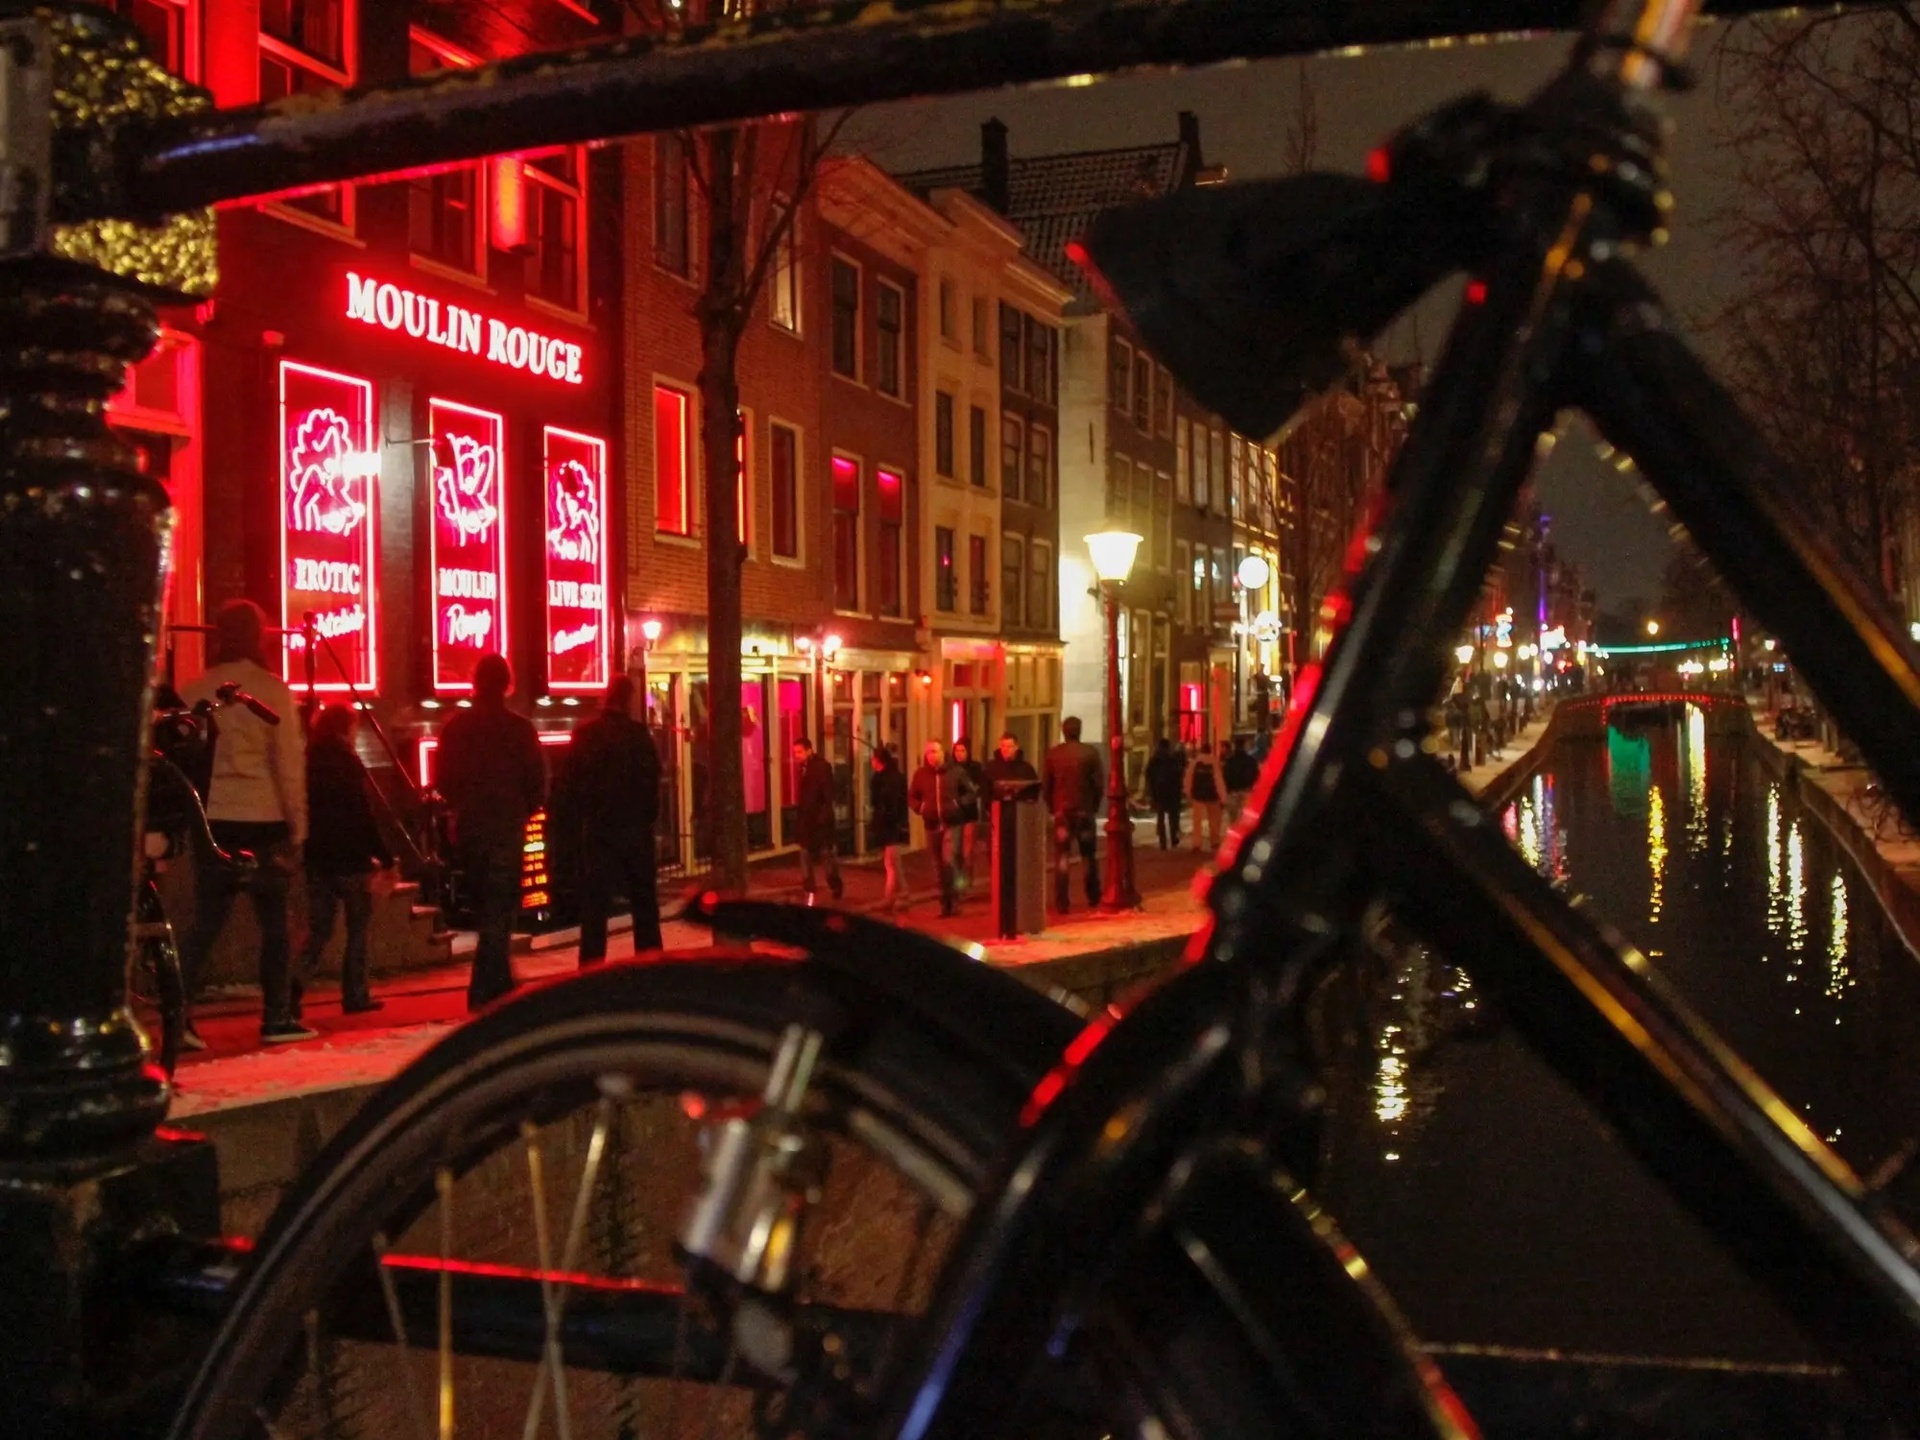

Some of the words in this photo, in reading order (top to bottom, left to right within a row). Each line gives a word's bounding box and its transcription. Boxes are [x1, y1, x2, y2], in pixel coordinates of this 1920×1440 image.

[346, 272, 482, 355] MOULIN
[488, 319, 583, 384] ROUGE
[294, 558, 361, 595] EROTIC
[439, 567, 497, 600] MOULIN
